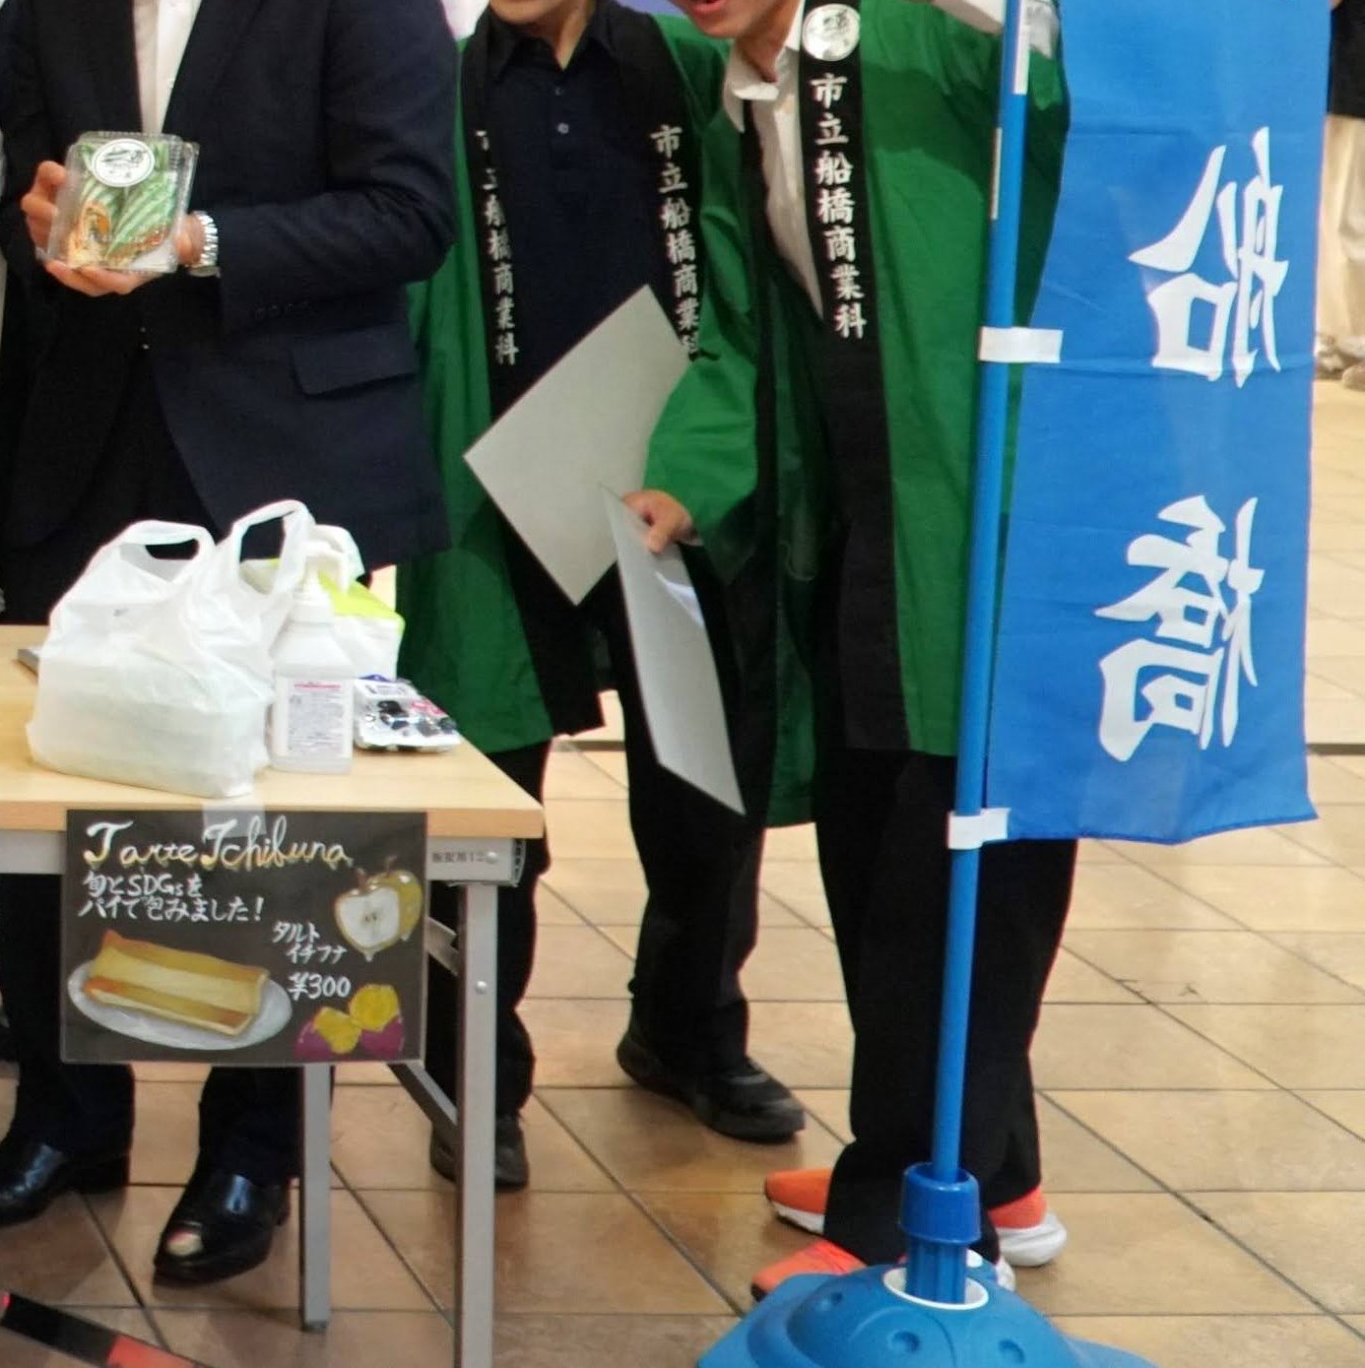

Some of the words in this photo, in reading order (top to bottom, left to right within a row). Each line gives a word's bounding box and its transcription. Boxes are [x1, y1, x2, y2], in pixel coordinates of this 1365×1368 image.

[810, 71, 867, 339] 市立船橋商業科
[272, 921, 321, 944] タルト
[286, 943, 348, 965] イチフナ
[288, 971, 352, 1000] ¥300
